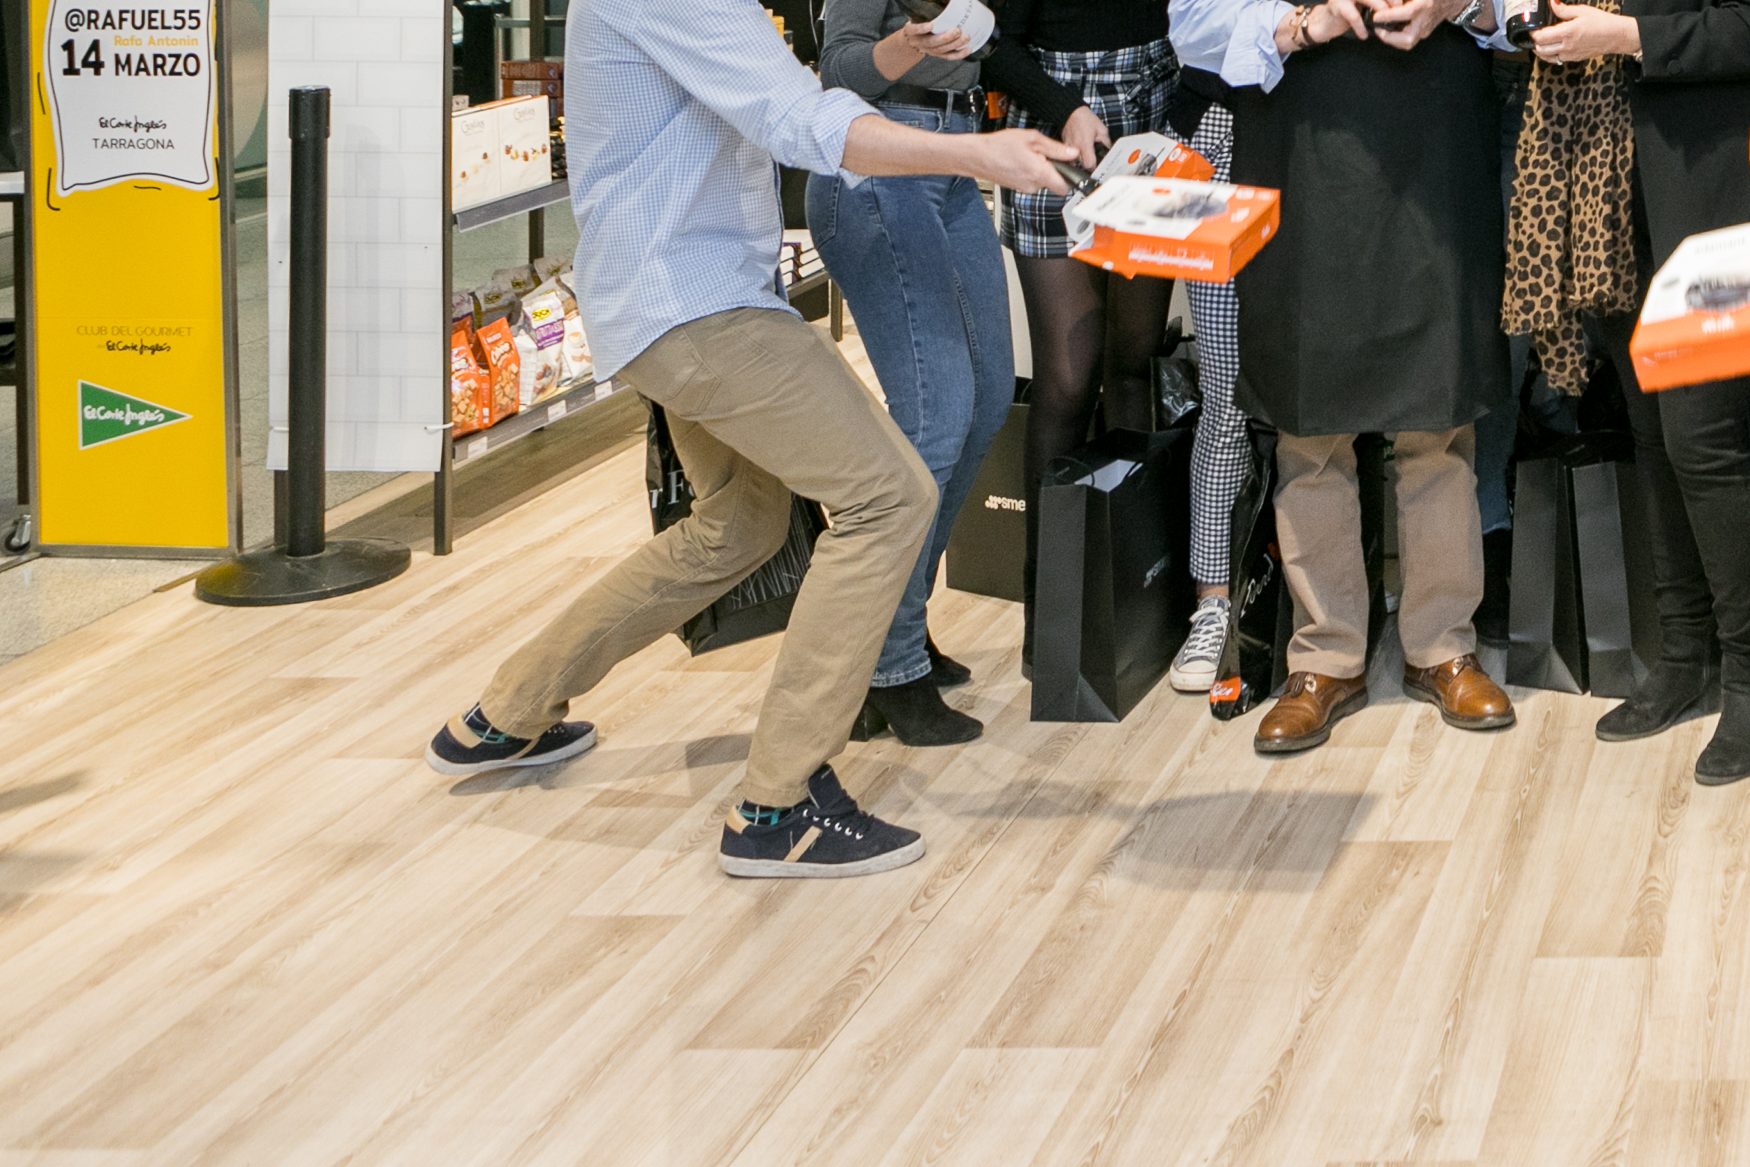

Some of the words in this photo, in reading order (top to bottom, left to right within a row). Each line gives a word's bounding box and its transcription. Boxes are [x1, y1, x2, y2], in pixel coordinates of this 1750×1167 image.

[65, 8, 201, 33] @RAFUEL55
[113, 35, 143, 46] Rafa
[61, 39, 105, 76] 14
[114, 53, 201, 76] MARZO
[109, 117, 133, 129] Corte
[134, 115, 167, 132] Inglés
[92, 138, 175, 150] TARRAGONA
[76, 325, 108, 336] CLUB
[111, 325, 133, 336] DEL
[135, 325, 193, 337] GOURMET
[116, 340, 138, 351] Corte
[139, 338, 171, 355] Inglés
[97, 406, 125, 421] Corte
[125, 403, 165, 425] Inglés
[1001, 496, 1026, 512] sme
